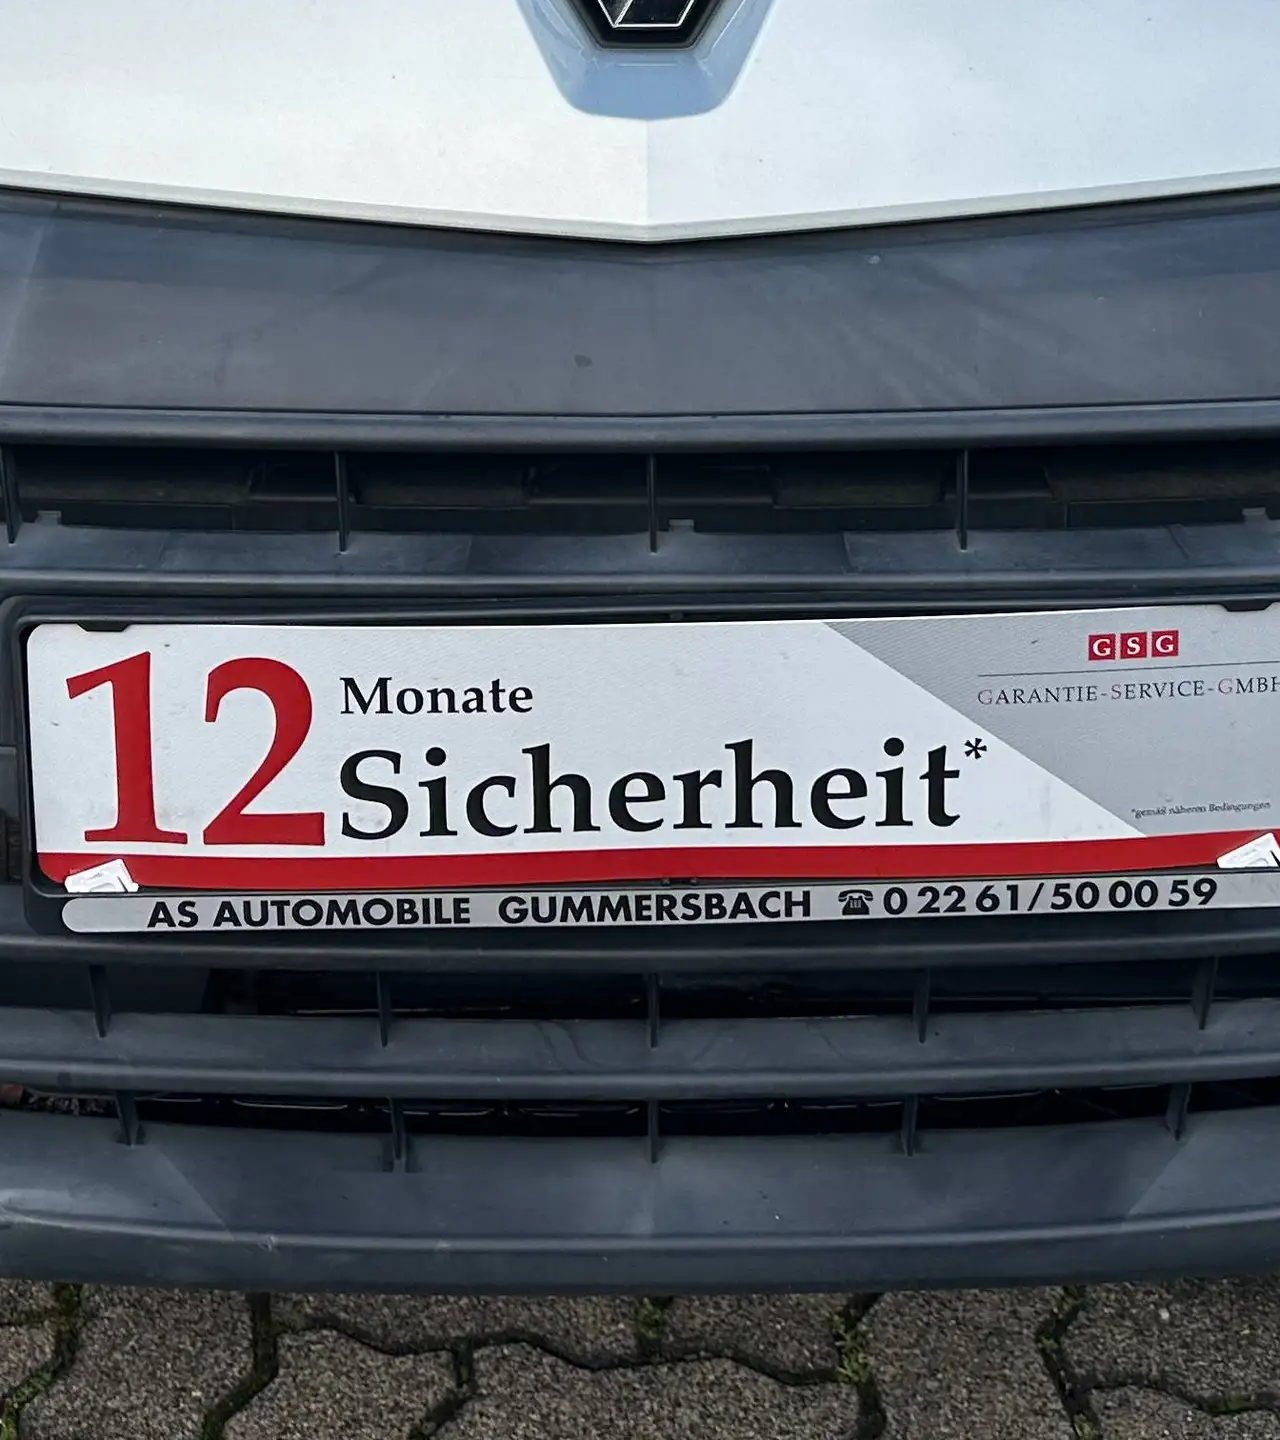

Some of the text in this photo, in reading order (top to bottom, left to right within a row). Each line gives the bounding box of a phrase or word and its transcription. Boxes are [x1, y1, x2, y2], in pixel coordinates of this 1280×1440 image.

[339, 675, 534, 716] Monate
[65, 650, 326, 847] 12
[148, 900, 199, 929] AS
[213, 897, 471, 927] AUTOMOBILE
[497, 889, 811, 925] GUMMERSBACH
